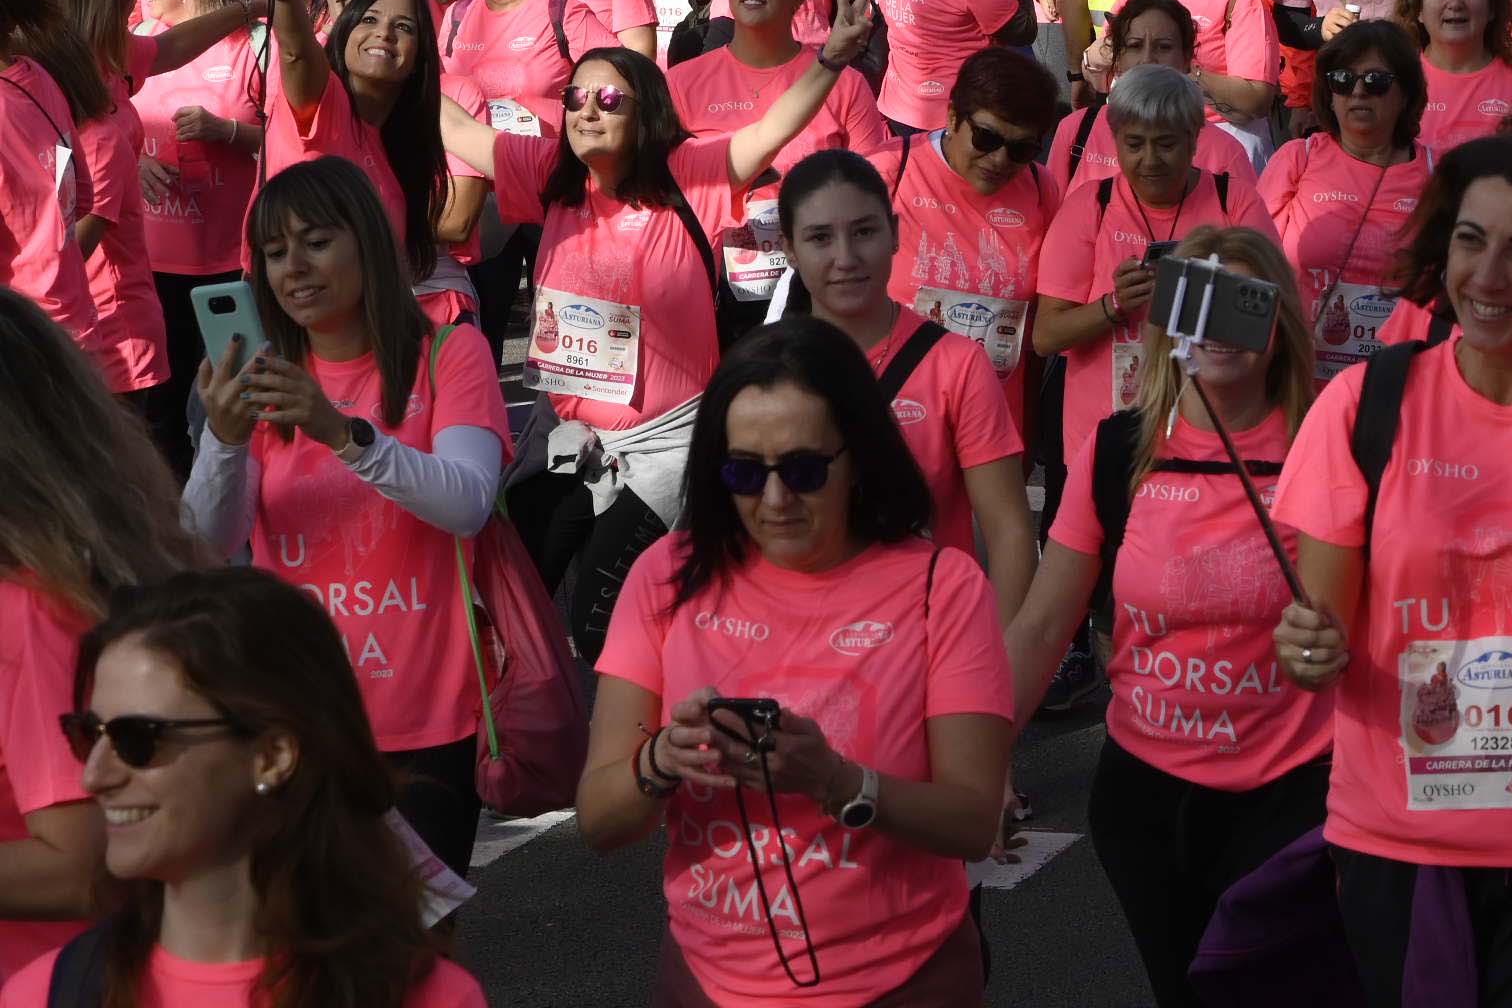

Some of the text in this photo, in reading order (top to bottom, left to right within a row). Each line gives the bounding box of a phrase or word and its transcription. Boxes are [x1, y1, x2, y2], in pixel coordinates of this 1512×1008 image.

[659, 7, 683, 17] 016
[885, 6, 916, 25] MUJER
[900, 0, 913, 12] LA
[708, 101, 754, 113] OYSHO
[563, 308, 602, 327] ASTURIANA
[951, 308, 992, 322] ASTURIANA
[1353, 325, 1377, 339] 01
[561, 335, 598, 354] 016
[566, 354, 589, 367] 8961
[537, 361, 565, 374] CARRERA
[565, 367, 575, 376] DE
[575, 369, 584, 377] LA
[585, 370, 608, 380] MUJER
[1407, 458, 1479, 481] OYSHO
[301, 576, 427, 617] RSAL
[1124, 603, 1167, 637] TU
[1394, 597, 1451, 634] TU
[694, 611, 770, 641] OYSHO
[370, 669, 393, 679] 2023
[1131, 645, 1281, 696] DORSAL
[1131, 686, 1238, 742] SUMA
[1426, 759, 1473, 770] CARRERA
[1475, 759, 1490, 769] DE
[1491, 758, 1506, 768] LA
[1423, 783, 1475, 798] OYSHO
[681, 813, 860, 870] DORSAL
[687, 863, 802, 926] SUMA
